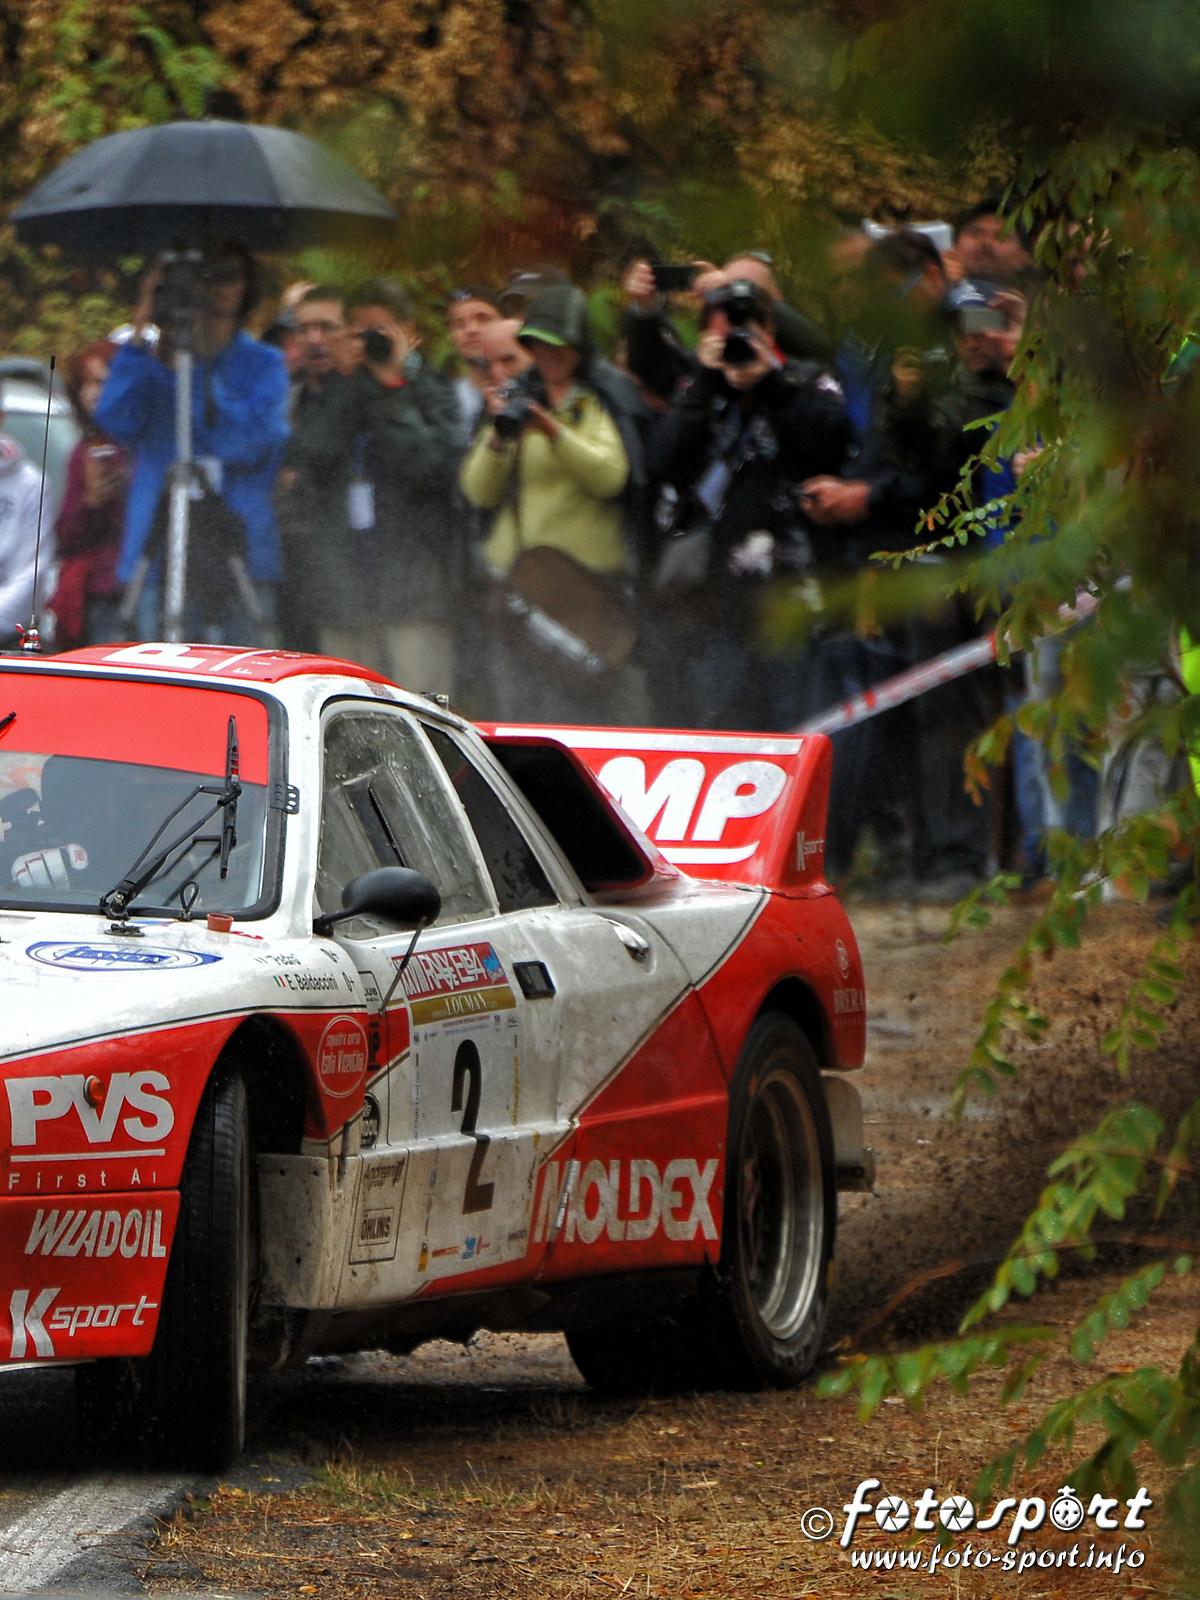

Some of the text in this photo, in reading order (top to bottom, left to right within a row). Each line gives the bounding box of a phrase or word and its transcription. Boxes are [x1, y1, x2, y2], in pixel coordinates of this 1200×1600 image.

[597, 756, 788, 842] MP
[295, 973, 340, 991] Baldaccini
[445, 993, 488, 1016] LOCMAN
[4, 1070, 176, 1147] PVS
[450, 1038, 496, 1216] 2
[8, 1170, 107, 1190] First
[533, 1158, 720, 1244] MOLDEX
